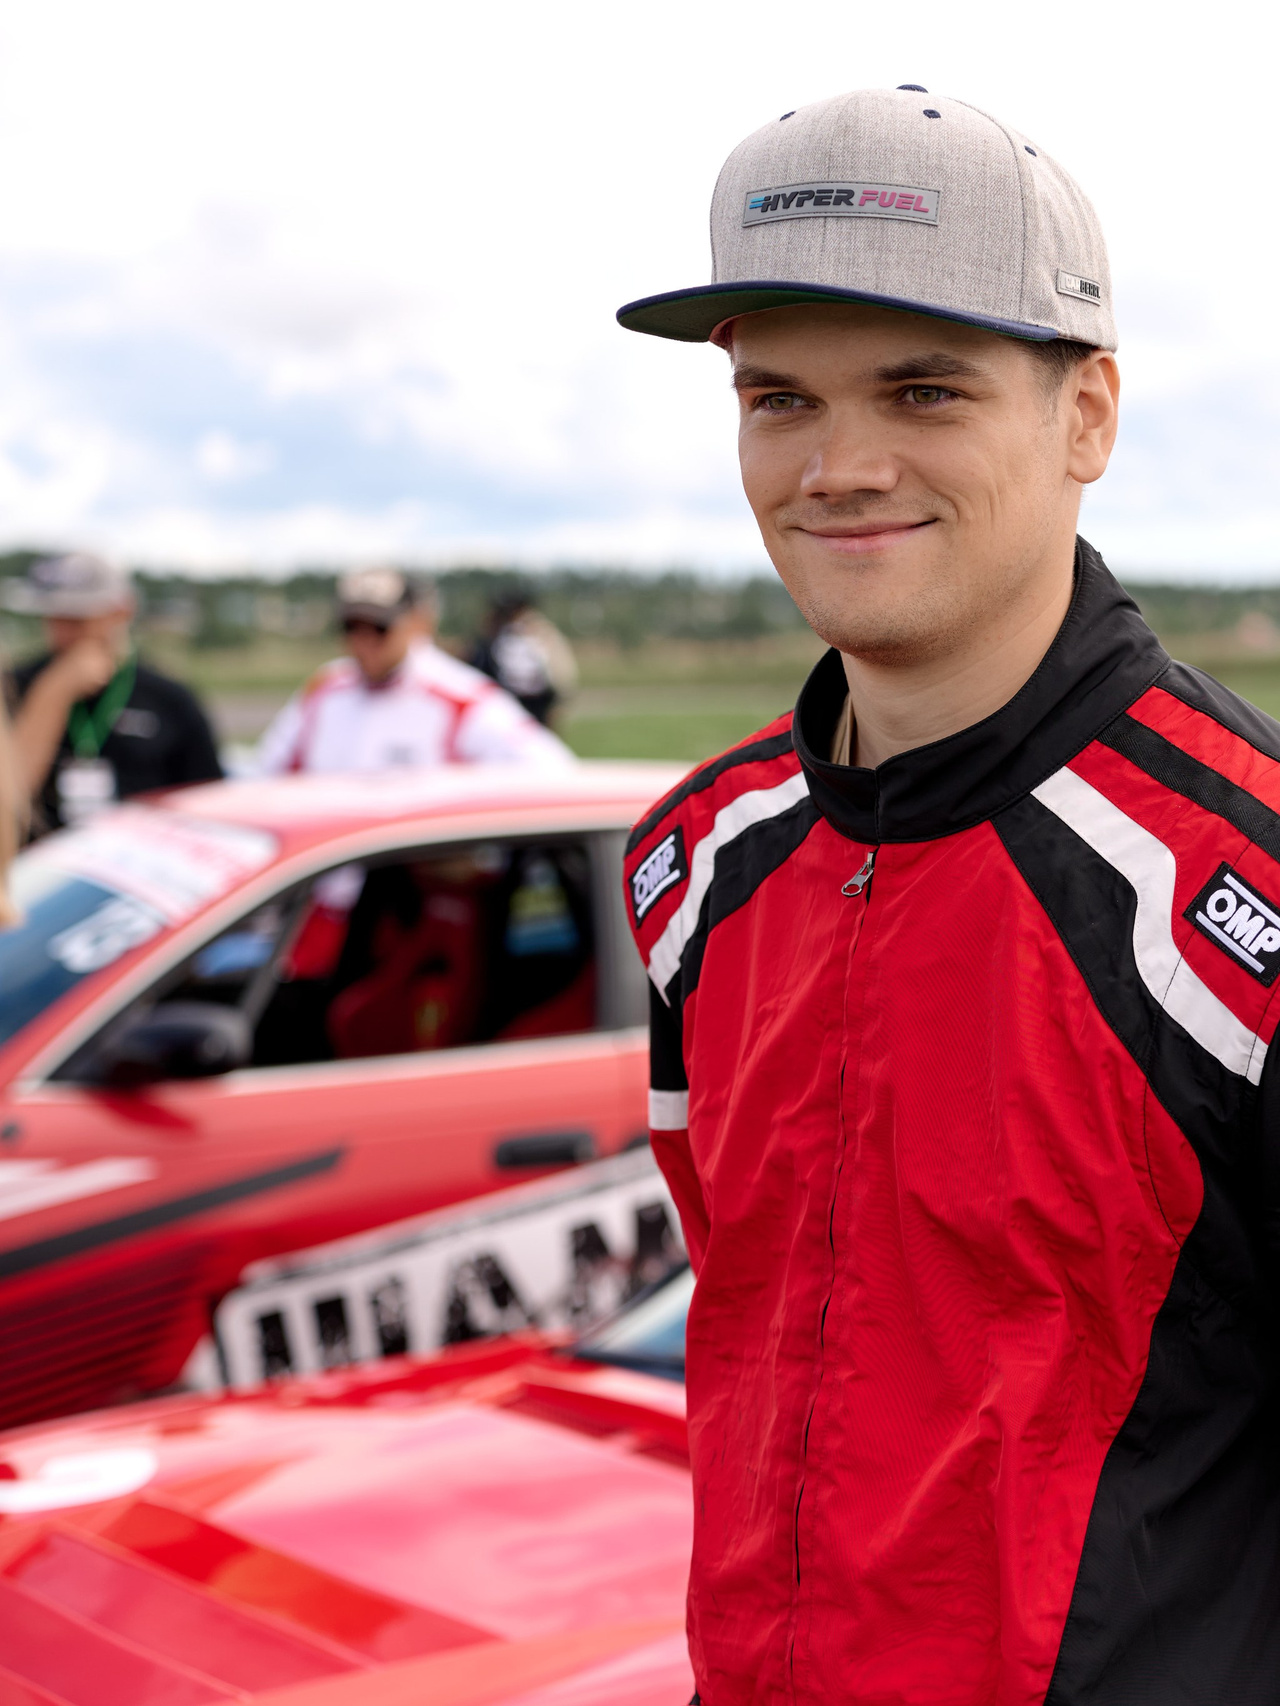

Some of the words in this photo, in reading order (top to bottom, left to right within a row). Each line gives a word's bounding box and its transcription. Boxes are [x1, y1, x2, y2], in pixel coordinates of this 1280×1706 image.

[750, 189, 855, 213] HYPER
[858, 189, 930, 213] FUEL
[634, 844, 676, 905] OMP
